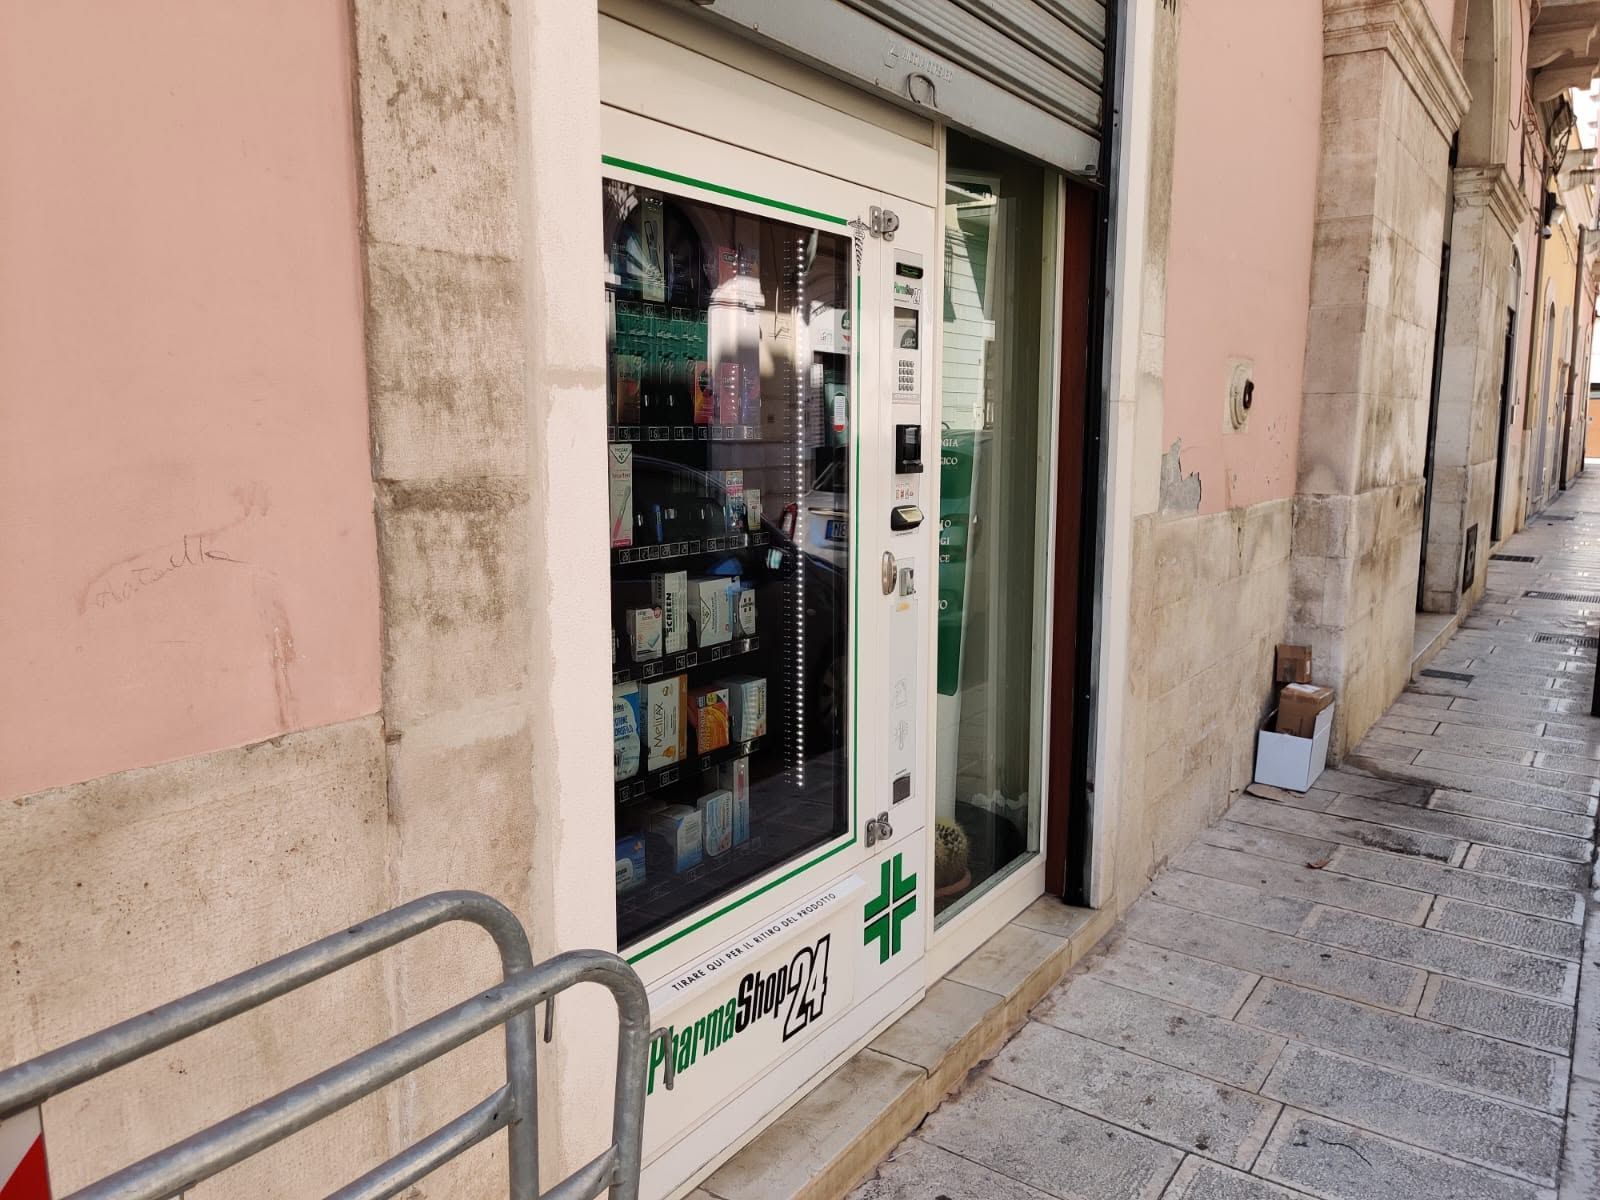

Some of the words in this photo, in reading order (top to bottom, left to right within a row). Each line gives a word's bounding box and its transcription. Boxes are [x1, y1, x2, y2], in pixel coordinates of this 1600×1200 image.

[942, 438, 959, 447] GIA
[940, 537, 950, 545] GI
[939, 554, 950, 562] CE
[665, 592, 673, 633] SCREEN
[672, 969, 706, 991] TIRARE
[706, 958, 726, 972] QUI
[726, 947, 743, 960] PER
[743, 941, 754, 950] IL
[753, 925, 781, 944] RITIRO
[781, 916, 798, 928] DEL
[797, 892, 837, 918] PRODOTTO
